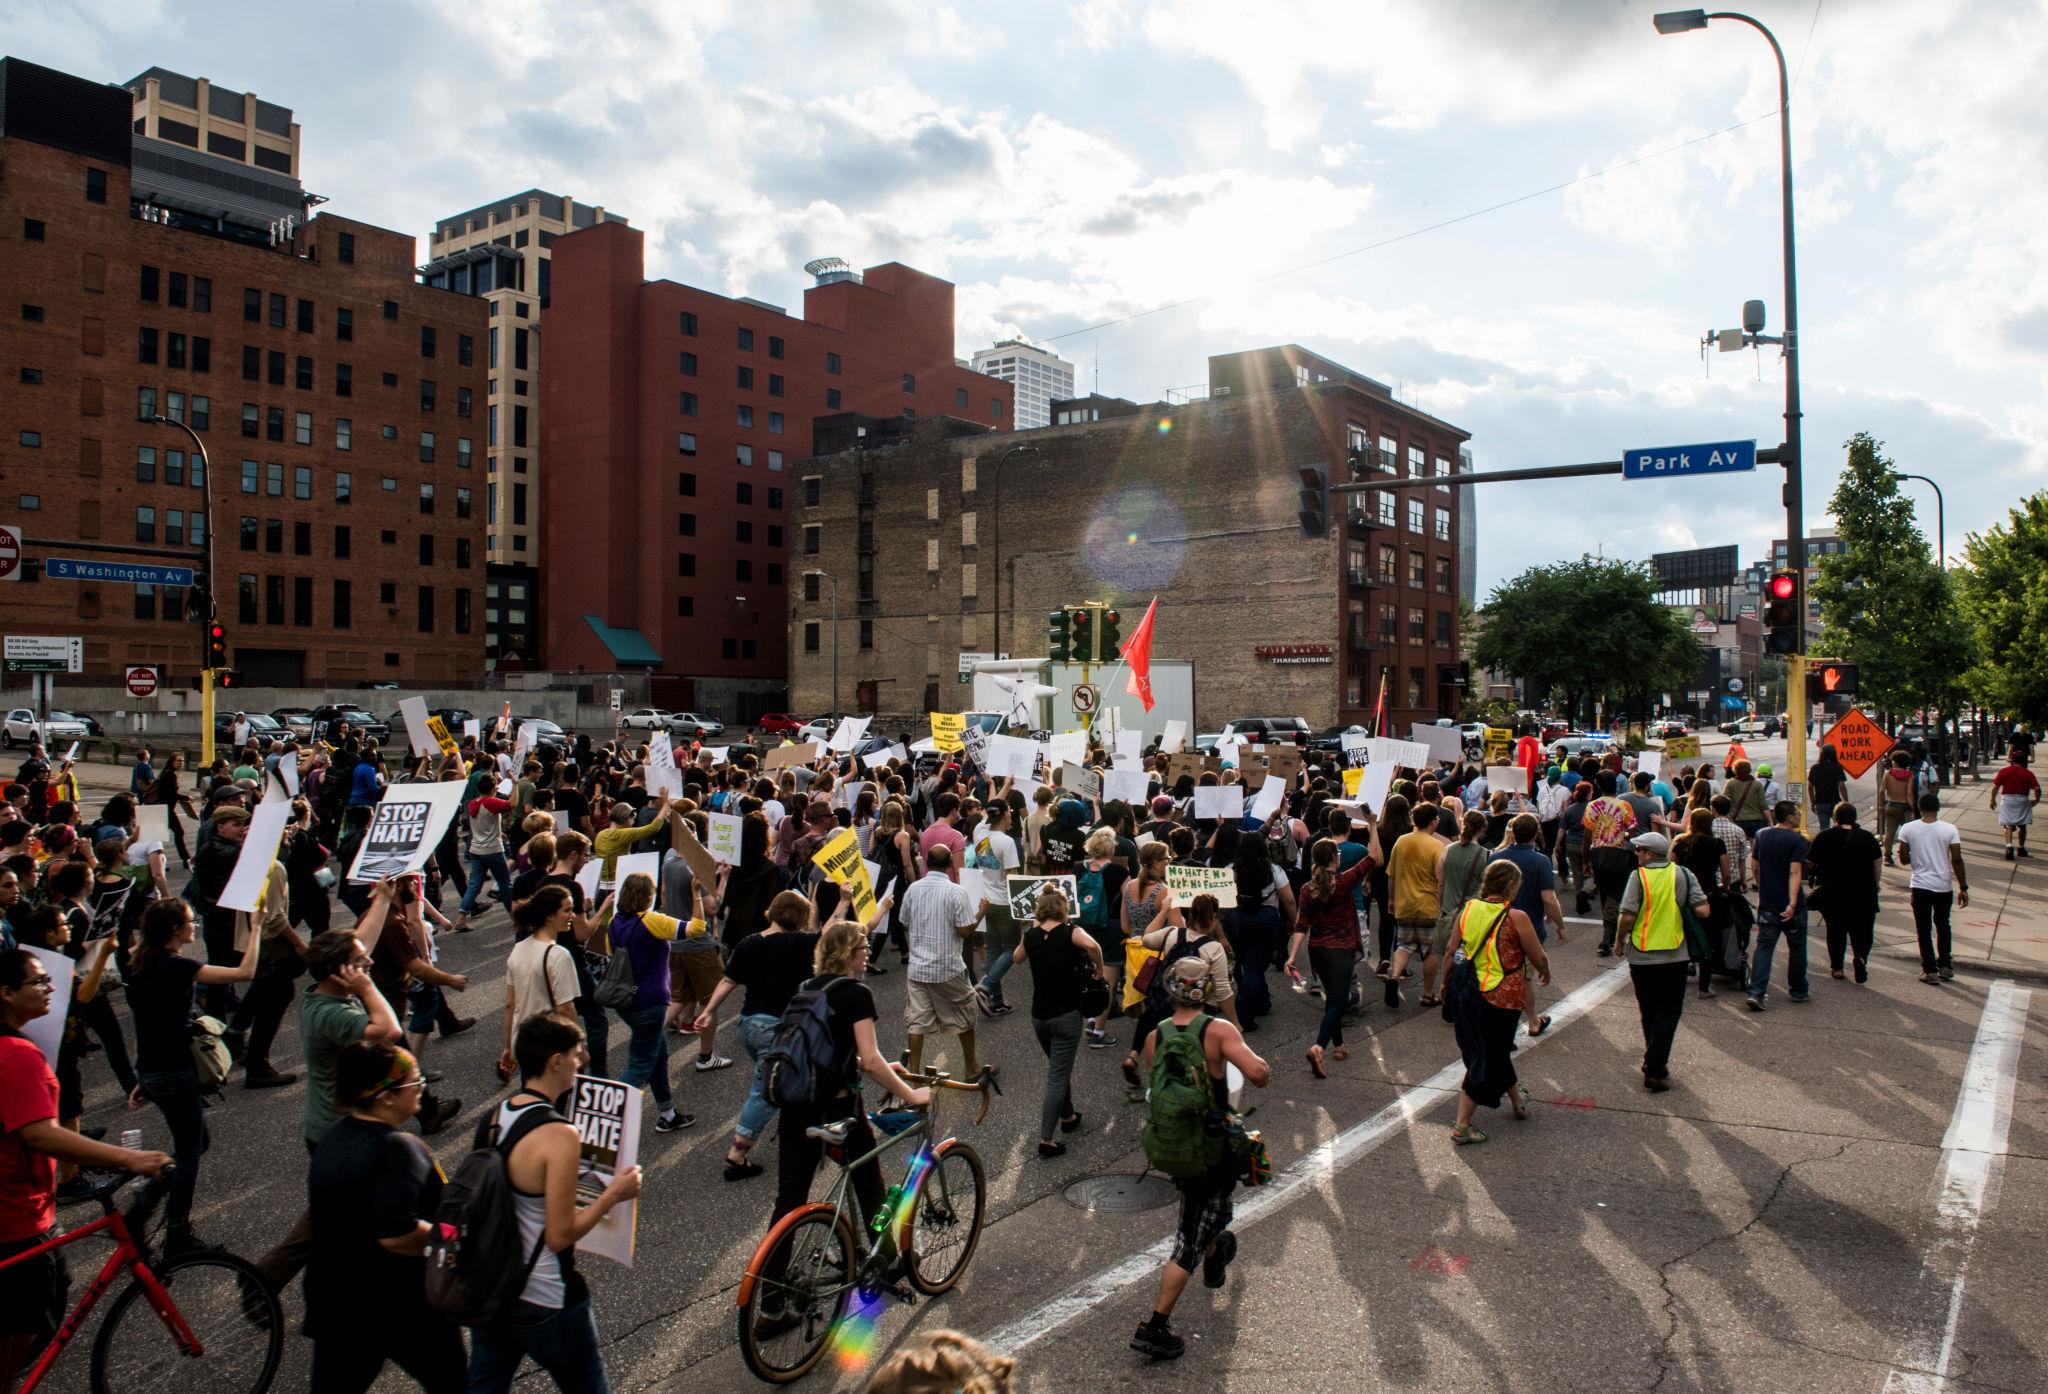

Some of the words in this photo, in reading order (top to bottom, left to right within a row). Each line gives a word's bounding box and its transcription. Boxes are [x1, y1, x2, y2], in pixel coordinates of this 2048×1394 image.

[1639, 453, 1690, 472] Park
[1708, 450, 1738, 466] Av
[0, 536, 12, 544] OT
[58, 563, 68, 574] S
[75, 565, 157, 581] Washington
[165, 571, 183, 582] Av
[1841, 724, 1870, 734] ROAD
[1841, 738, 1871, 747] WORK
[1349, 747, 1367, 757] STOP
[1840, 752, 1874, 761] AHEAD
[379, 803, 427, 822] STOP
[370, 823, 424, 843] HATE
[1168, 866, 1183, 876] NO
[578, 1082, 625, 1116] STOP
[574, 1112, 622, 1152] HATE
